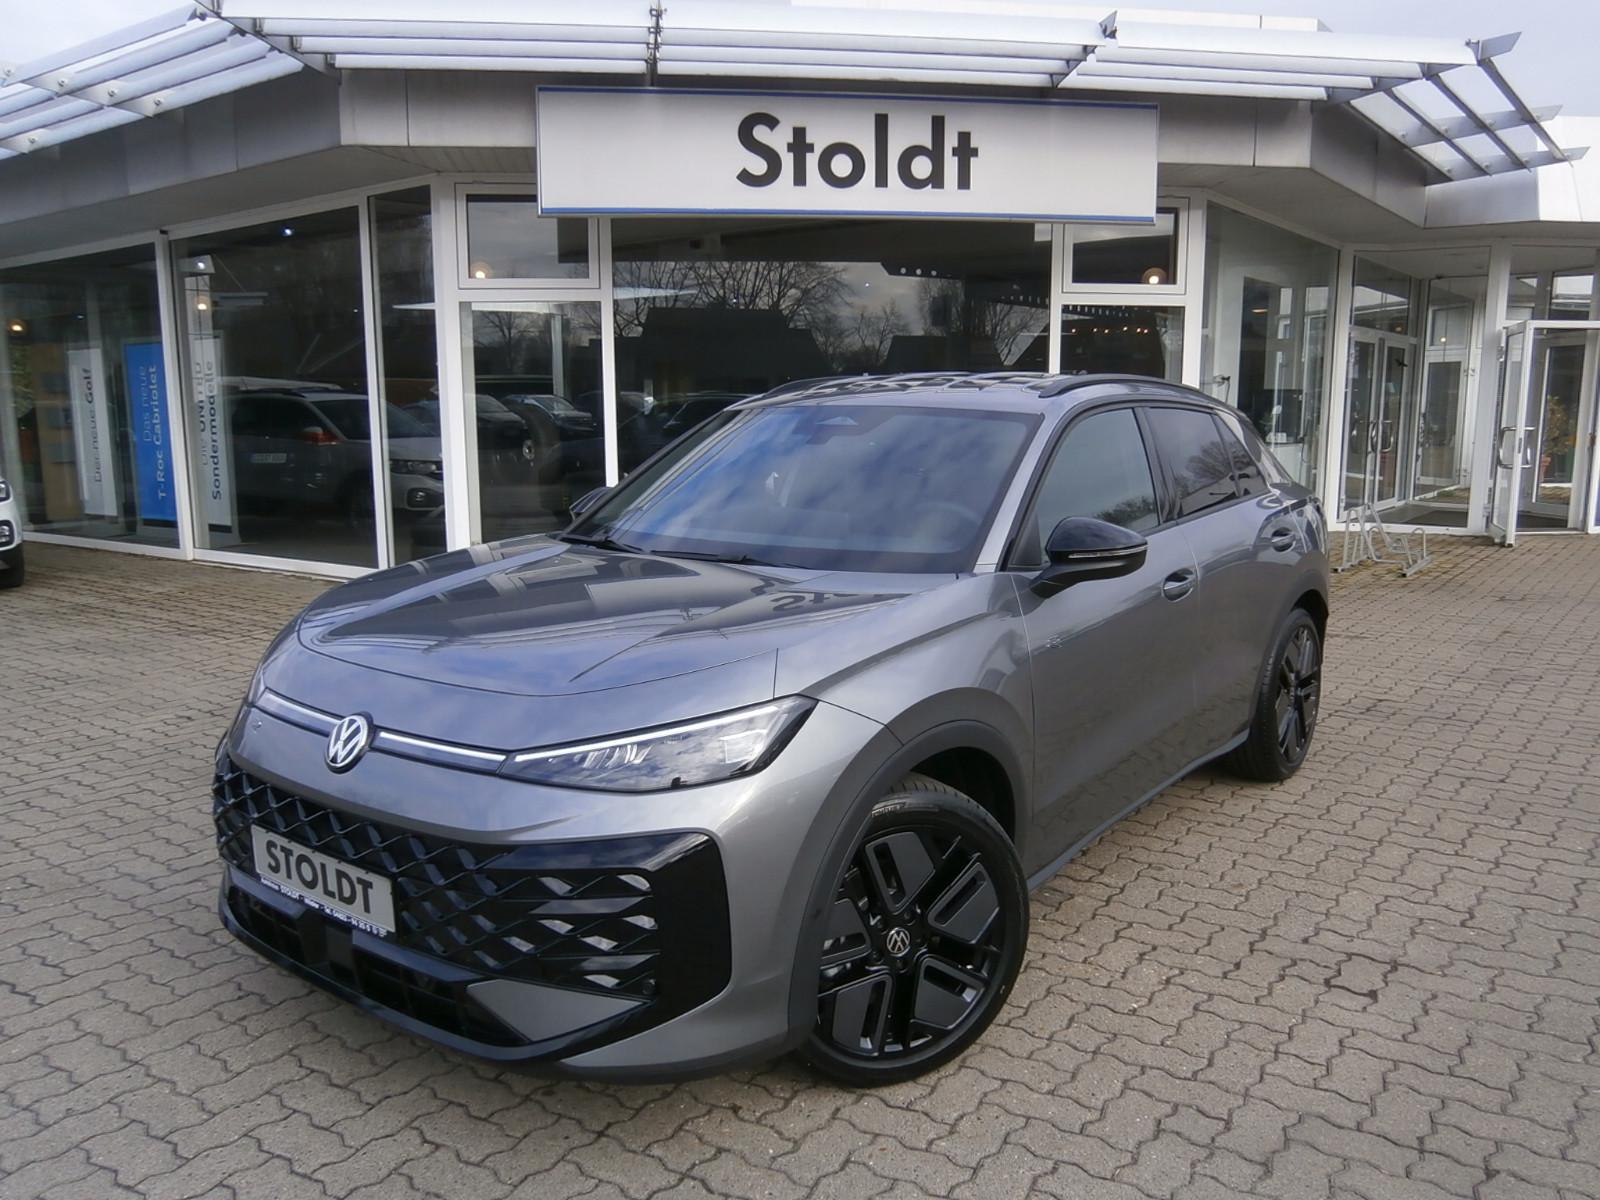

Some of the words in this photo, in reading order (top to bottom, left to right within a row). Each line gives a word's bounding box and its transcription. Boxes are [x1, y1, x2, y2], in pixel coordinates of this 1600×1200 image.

[736, 112, 979, 190] Stoldt
[82, 367, 95, 404] Golf
[139, 365, 150, 407] neue
[149, 364, 162, 445] Cabriolet
[143, 412, 153, 443] Das
[204, 360, 222, 500] Sondermodelle
[156, 449, 167, 500] T-Roc
[265, 839, 374, 915] STOLDT
